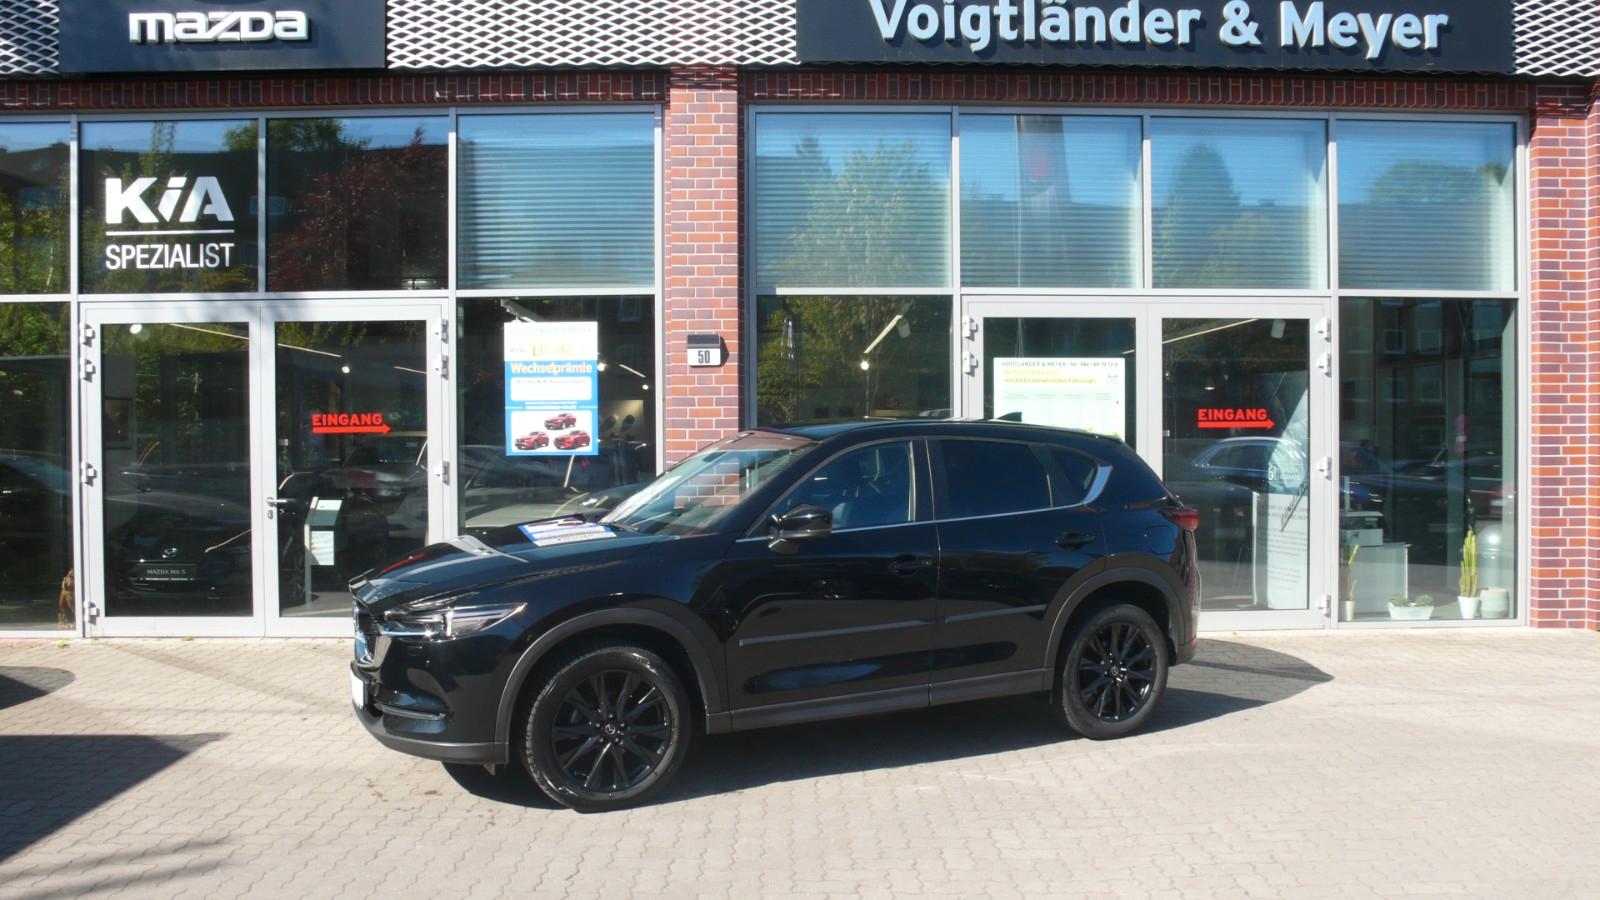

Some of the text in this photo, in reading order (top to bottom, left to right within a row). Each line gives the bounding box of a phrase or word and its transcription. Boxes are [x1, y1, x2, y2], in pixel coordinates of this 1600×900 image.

[870, 0, 1449, 59] Voigtländer & Meyer
[105, 242, 235, 270] SPEZIALIST
[697, 350, 711, 364] 50
[510, 361, 593, 375] Wechselprämie
[311, 412, 383, 426] EINGANG
[1197, 408, 1268, 421] EINGANG
